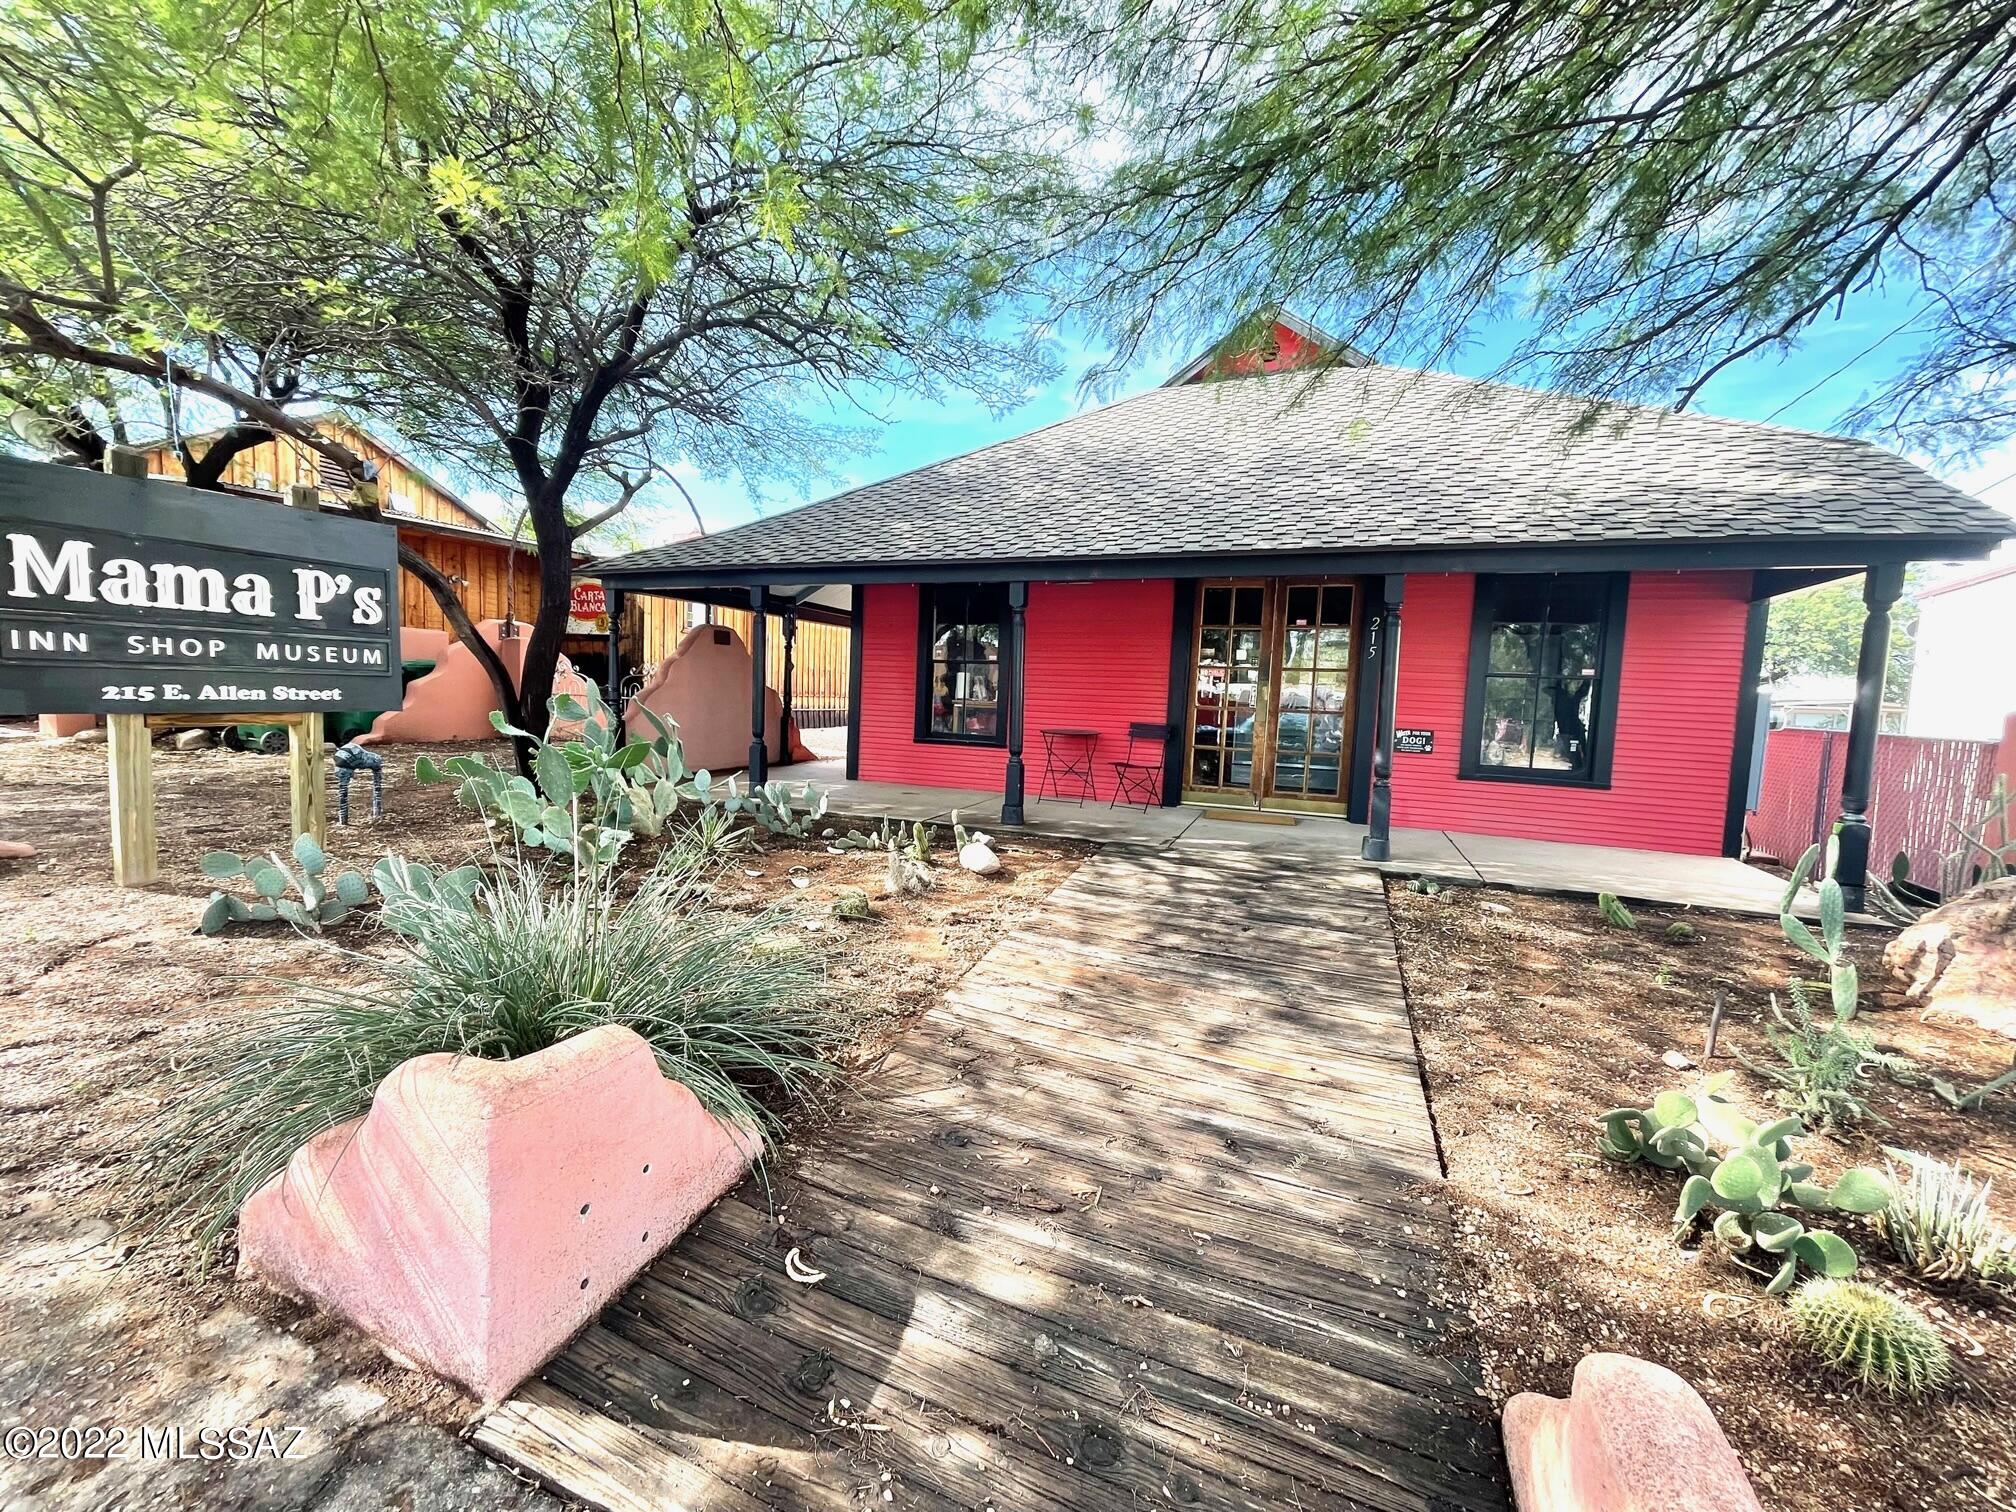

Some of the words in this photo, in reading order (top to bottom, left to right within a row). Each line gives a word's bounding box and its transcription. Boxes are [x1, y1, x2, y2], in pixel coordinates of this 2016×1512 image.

[6, 533, 275, 617] Mama
[292, 567, 384, 625] P's
[570, 600, 606, 612] BLANCA
[574, 587, 605, 602] CARTA
[11, 629, 89, 653] INN
[127, 635, 226, 658] SHOP
[256, 643, 383, 665] MUSEUM
[1368, 617, 1380, 659] 215
[101, 685, 155, 702] 215
[162, 685, 191, 701] E.
[197, 685, 267, 701] Allen
[272, 687, 342, 702] Street
